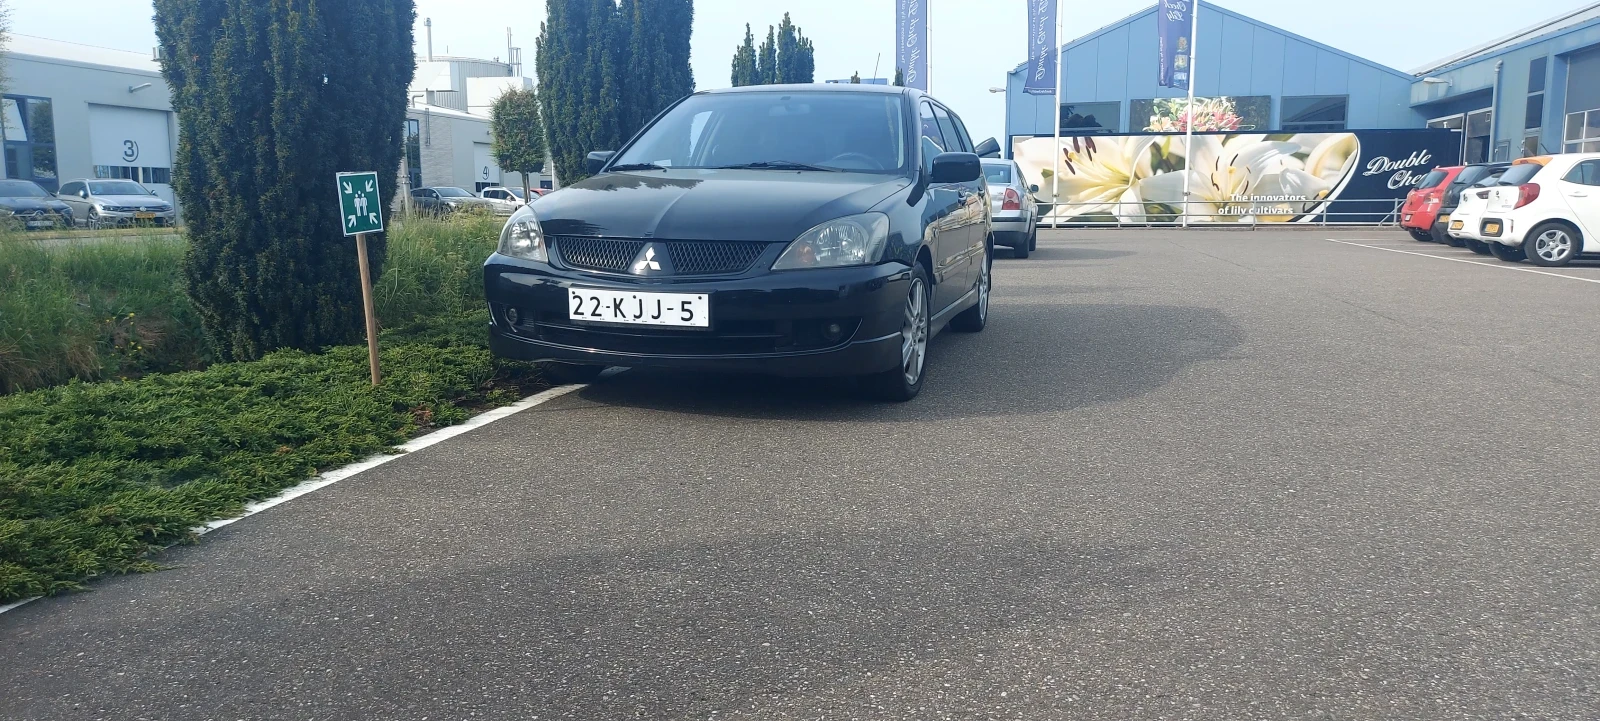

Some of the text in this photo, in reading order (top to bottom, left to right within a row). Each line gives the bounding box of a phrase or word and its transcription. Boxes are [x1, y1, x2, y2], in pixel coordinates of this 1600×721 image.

[123, 139, 135, 158] 3
[1363, 149, 1432, 176] Double
[1218, 206, 1229, 215] of
[572, 295, 694, 322] 22-KJJ-5
